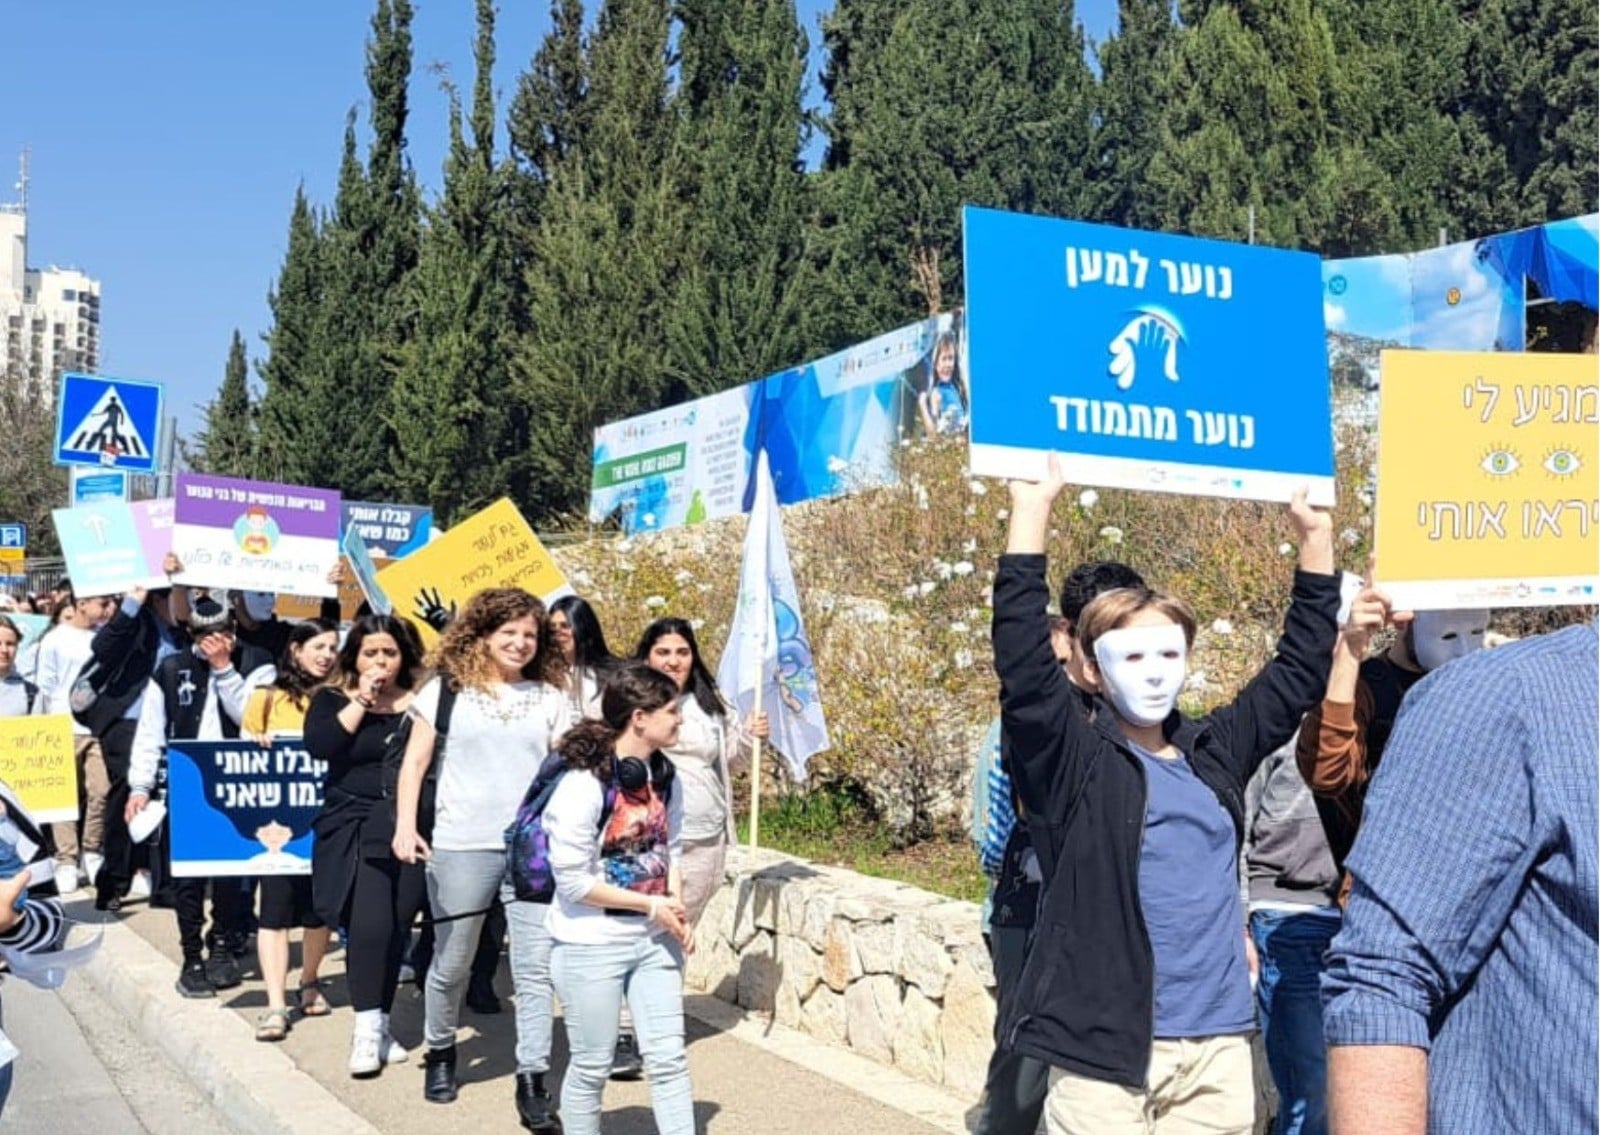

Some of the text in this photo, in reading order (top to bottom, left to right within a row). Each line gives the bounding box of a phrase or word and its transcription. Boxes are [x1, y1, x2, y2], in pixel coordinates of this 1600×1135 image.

[1065, 246, 1233, 299] נוער למען
[1464, 375, 1599, 427] מגיע לי
[1049, 395, 1255, 449] נוער מתמודד
[215, 487, 229, 501] בני
[231, 488, 246, 502] של
[349, 506, 411, 526] קבלו אותי
[1418, 501, 1507, 540] אותי
[386, 526, 410, 542] כמו
[215, 751, 269, 774] אותי
[215, 782, 281, 808] שאני
